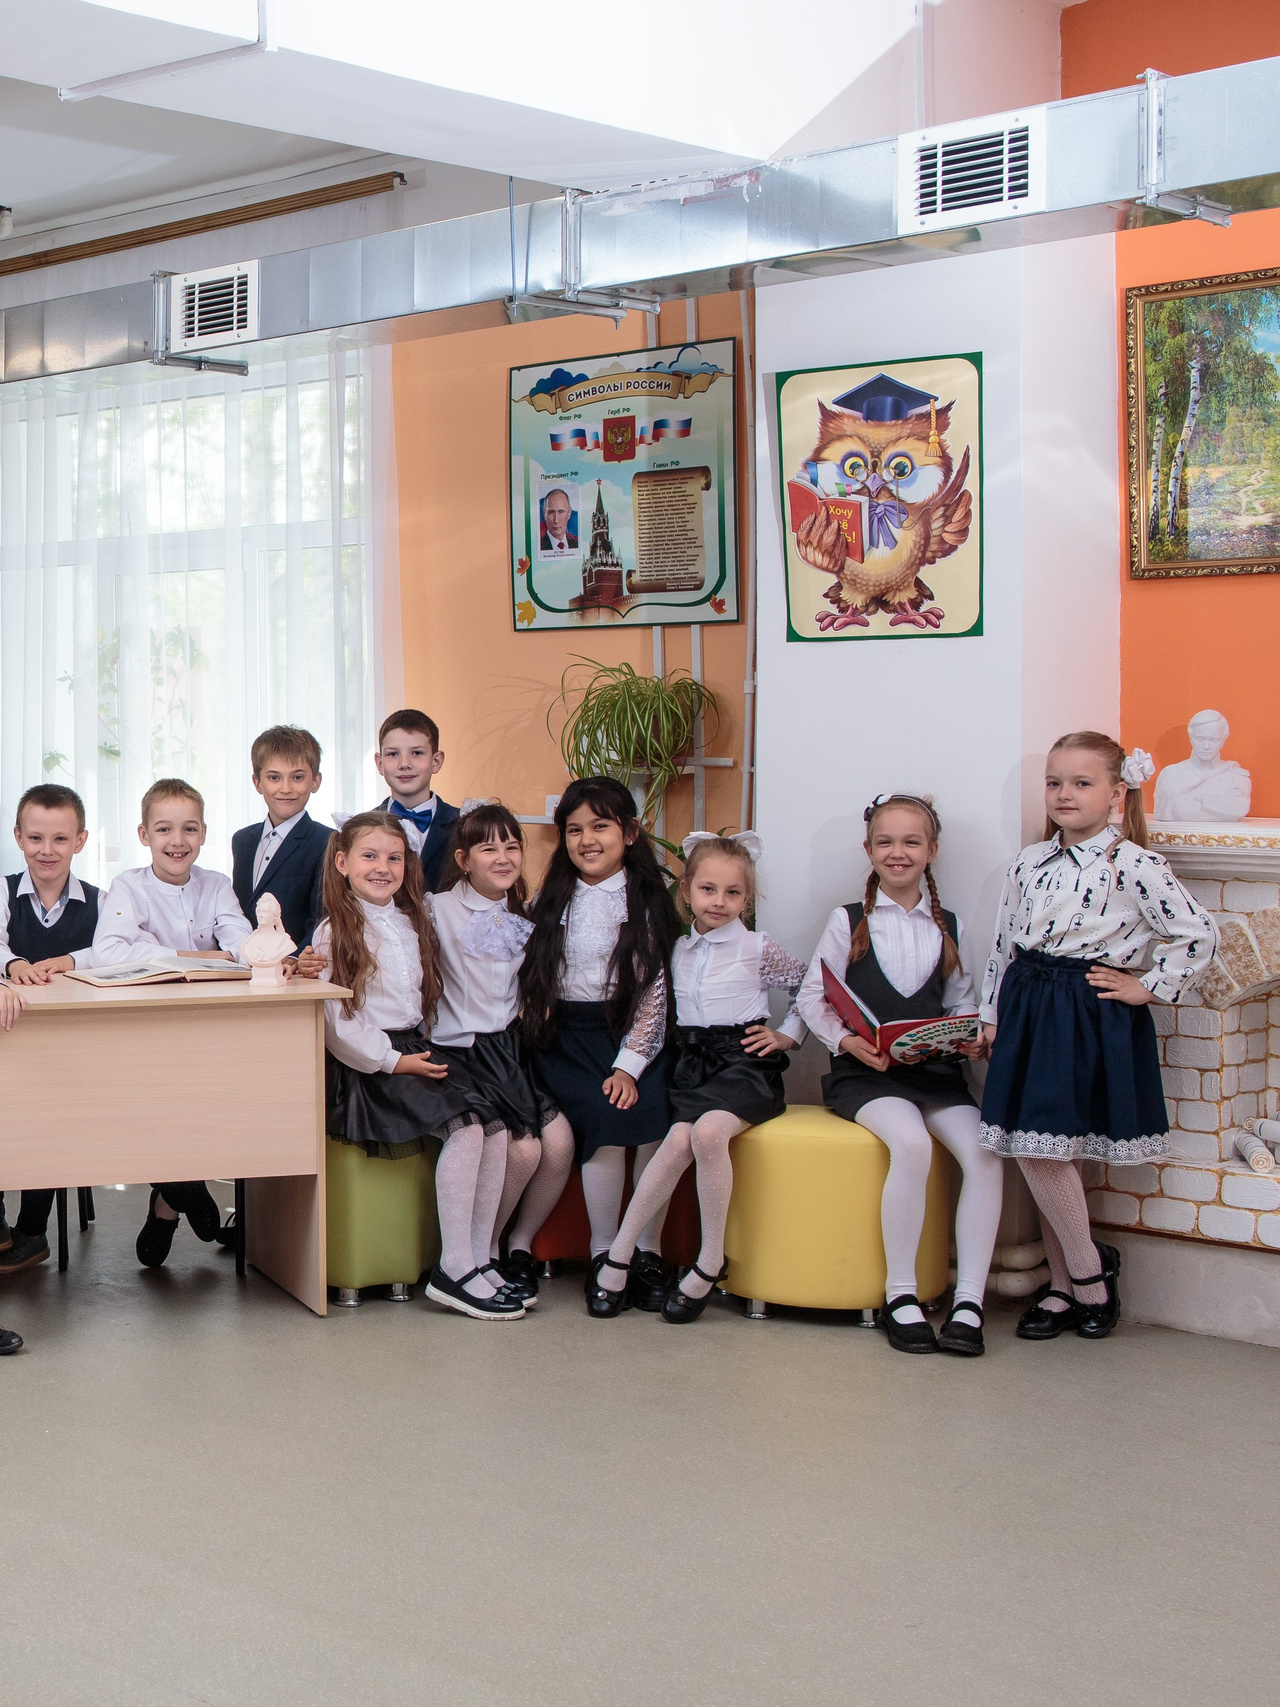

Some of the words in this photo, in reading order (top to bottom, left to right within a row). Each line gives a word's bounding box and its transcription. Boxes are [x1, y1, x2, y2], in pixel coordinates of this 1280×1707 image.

[567, 382, 622, 402] СИМВОЛЫ
[626, 380, 671, 390] РОССИИ
[829, 505, 853, 519] Хочу
